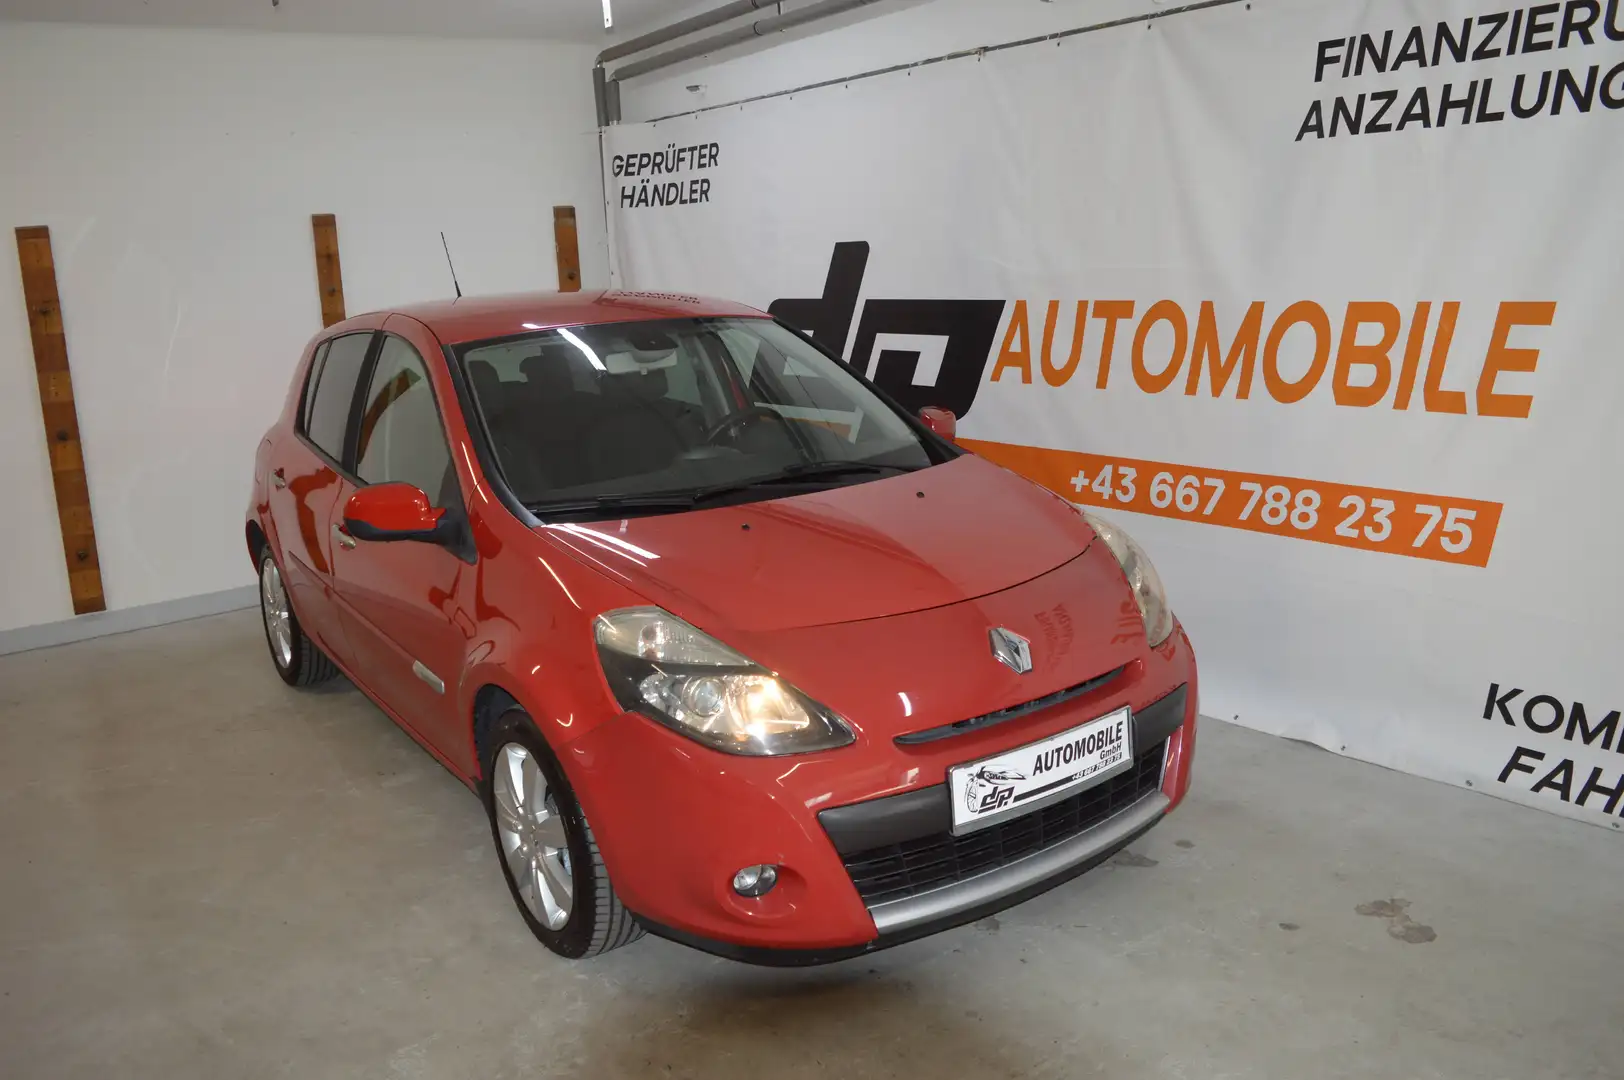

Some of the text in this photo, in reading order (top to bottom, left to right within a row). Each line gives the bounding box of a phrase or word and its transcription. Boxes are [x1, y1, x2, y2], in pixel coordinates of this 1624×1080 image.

[1295, 61, 1624, 142] ANZAHLUNG
[612, 142, 720, 178] GEPRÜFTER
[620, 178, 711, 209] HÄNDLER
[990, 299, 1557, 419] AUTOMOBILE
[1070, 463, 1478, 554] +43 667 788 23 75
[1032, 721, 1123, 776] AUTOMOBILE
[1100, 741, 1122, 760] GmbH
[1482, 682, 1624, 753] KOM
[1497, 745, 1624, 819] FAH
